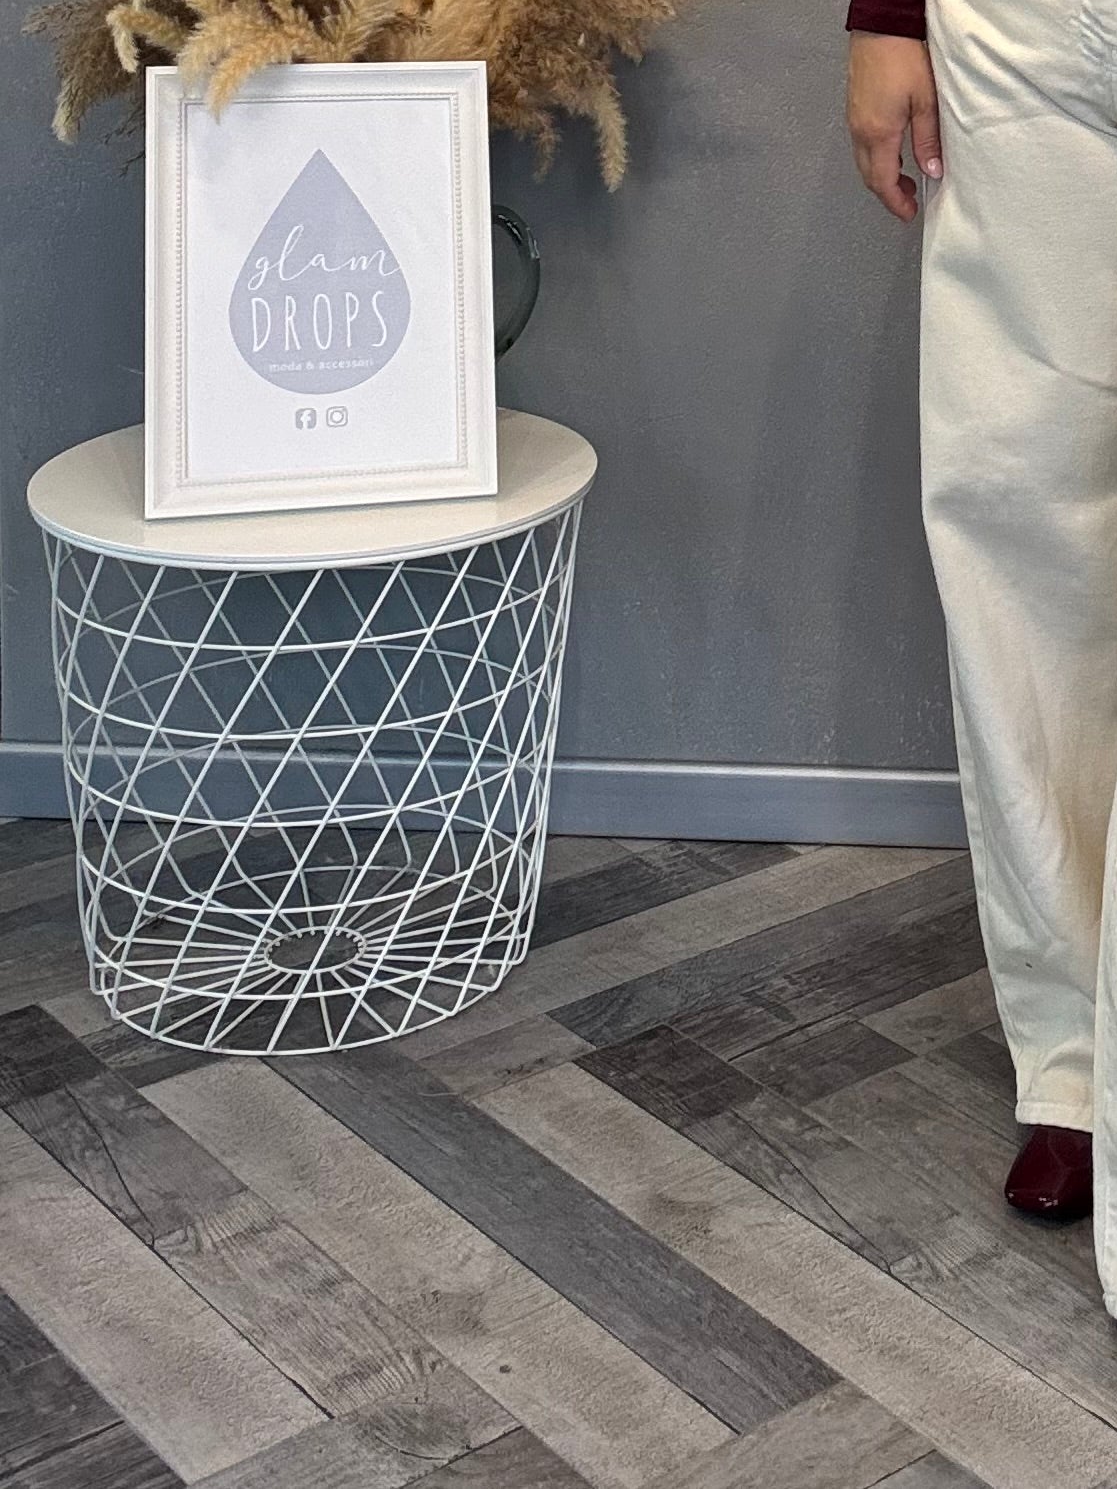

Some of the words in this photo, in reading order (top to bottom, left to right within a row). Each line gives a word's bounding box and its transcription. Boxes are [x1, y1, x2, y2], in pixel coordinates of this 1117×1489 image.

[247, 224, 402, 290] glam
[251, 290, 388, 352] DROPS
[305, 361, 314, 370] &
[319, 357, 375, 370] accessori
